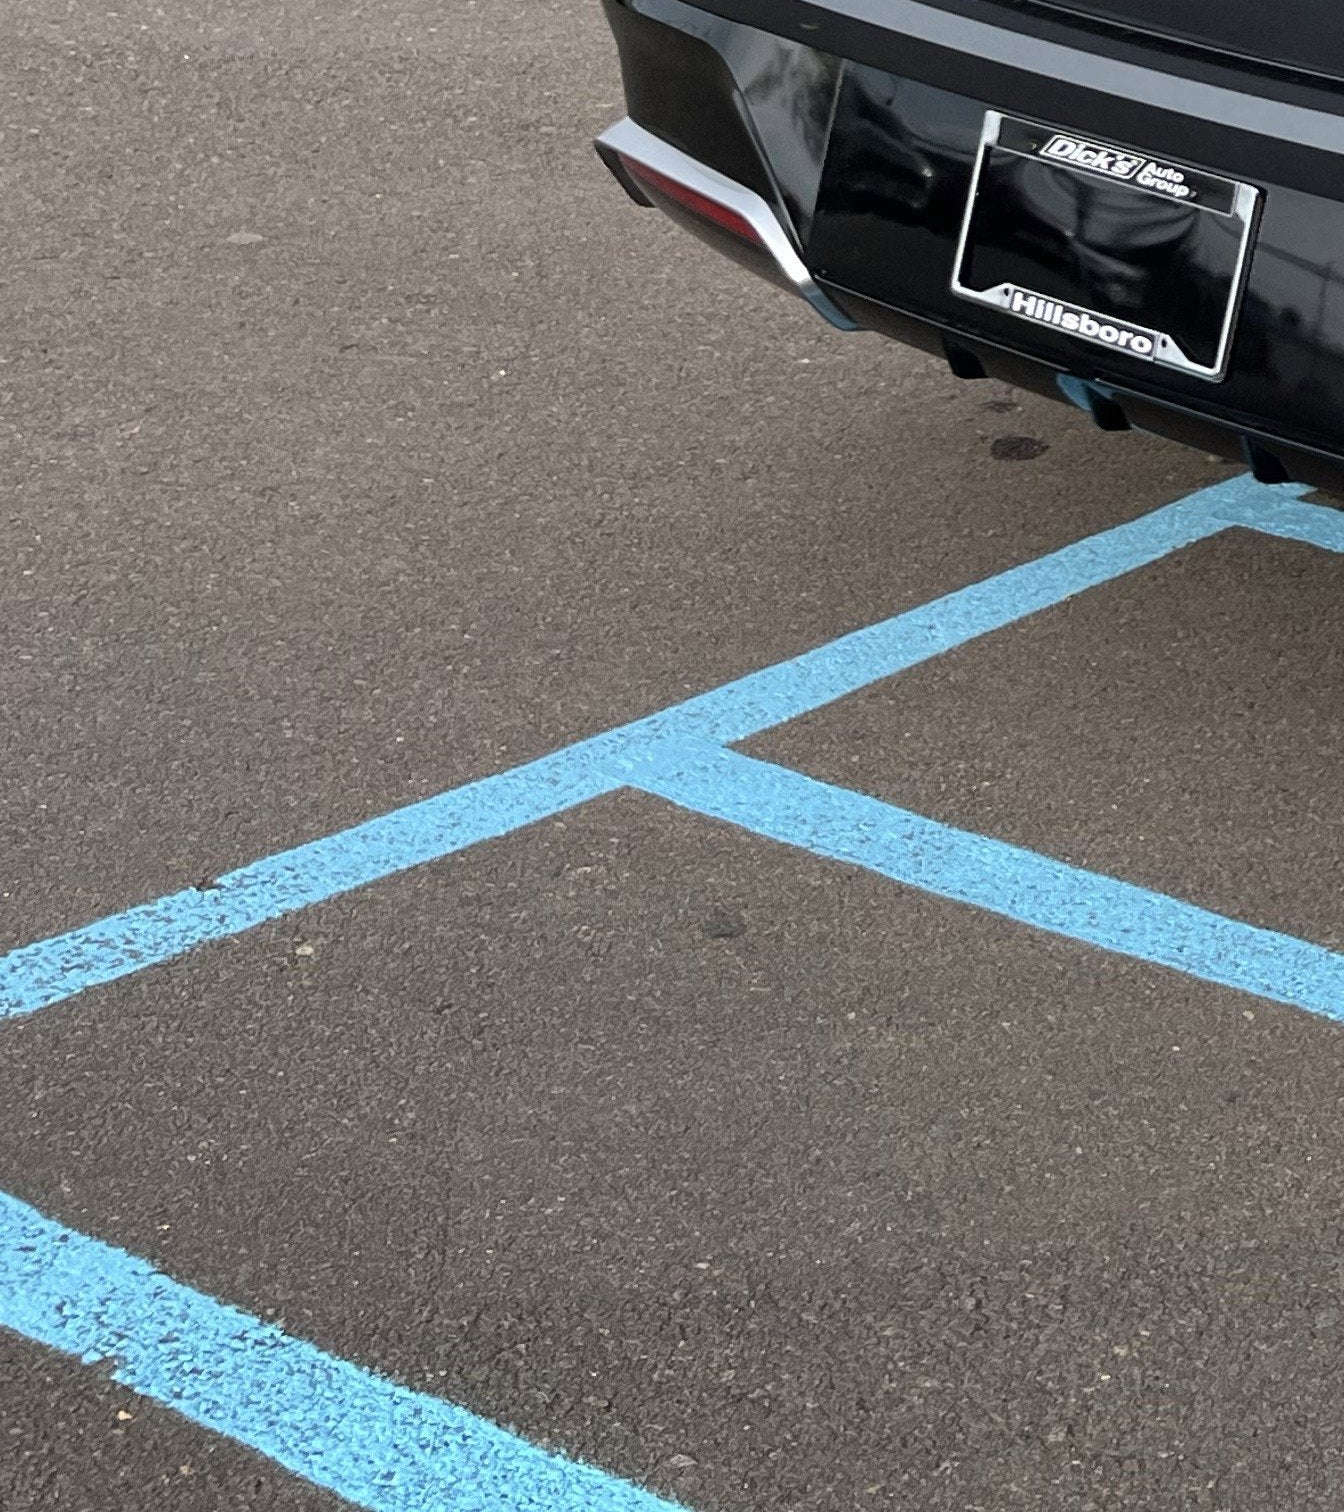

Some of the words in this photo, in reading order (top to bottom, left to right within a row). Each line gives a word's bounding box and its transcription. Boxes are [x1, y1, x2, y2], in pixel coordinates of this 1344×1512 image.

[1049, 138, 1138, 175] Dick's
[1136, 171, 1190, 197] Group
[1145, 162, 1185, 183] Auto
[1012, 291, 1152, 354] Hillsboro
